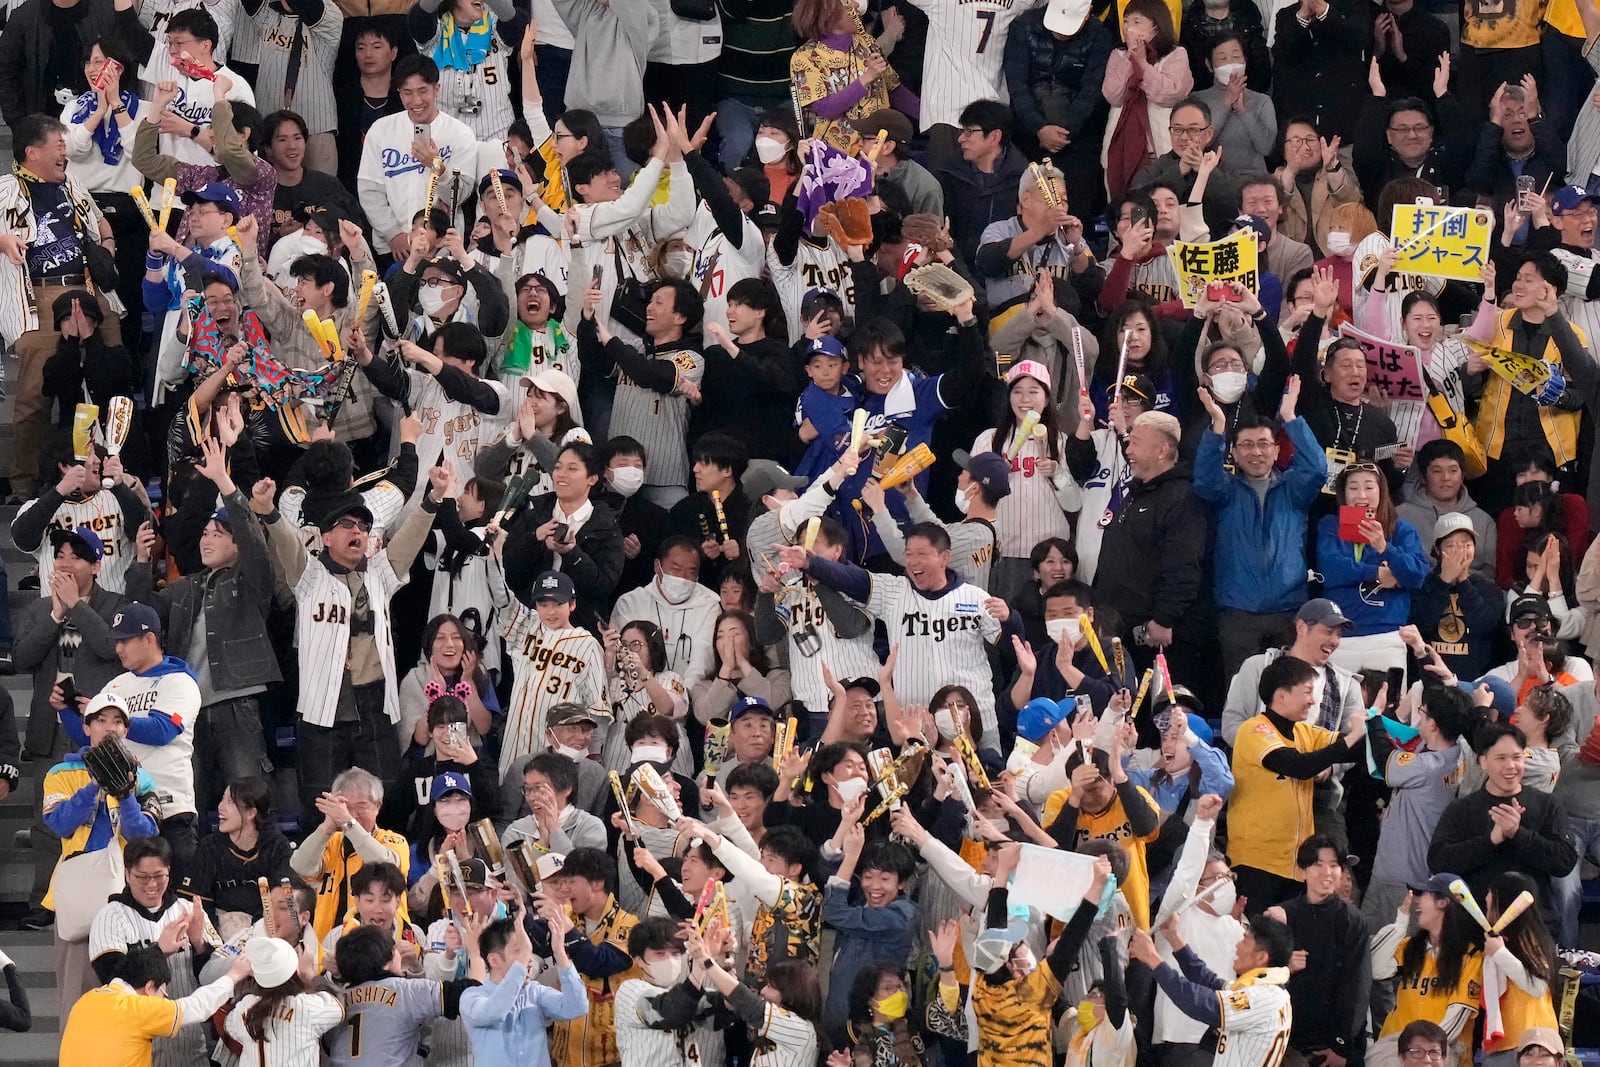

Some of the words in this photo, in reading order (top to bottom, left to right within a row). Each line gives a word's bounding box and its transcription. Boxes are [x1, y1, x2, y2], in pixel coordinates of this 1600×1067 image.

[976, 11, 996, 53] 7
[484, 67, 497, 85] 5
[1412, 208, 1468, 239] 打倒
[1180, 242, 1240, 275] 佐藤
[1213, 270, 1256, 295] 明
[902, 611, 983, 642] Tigers
[522, 634, 586, 674] Tigers
[546, 676, 573, 701] 31
[445, 775, 458, 788] LA
[347, 1012, 363, 1058] 1
[687, 1043, 699, 1063] 4
